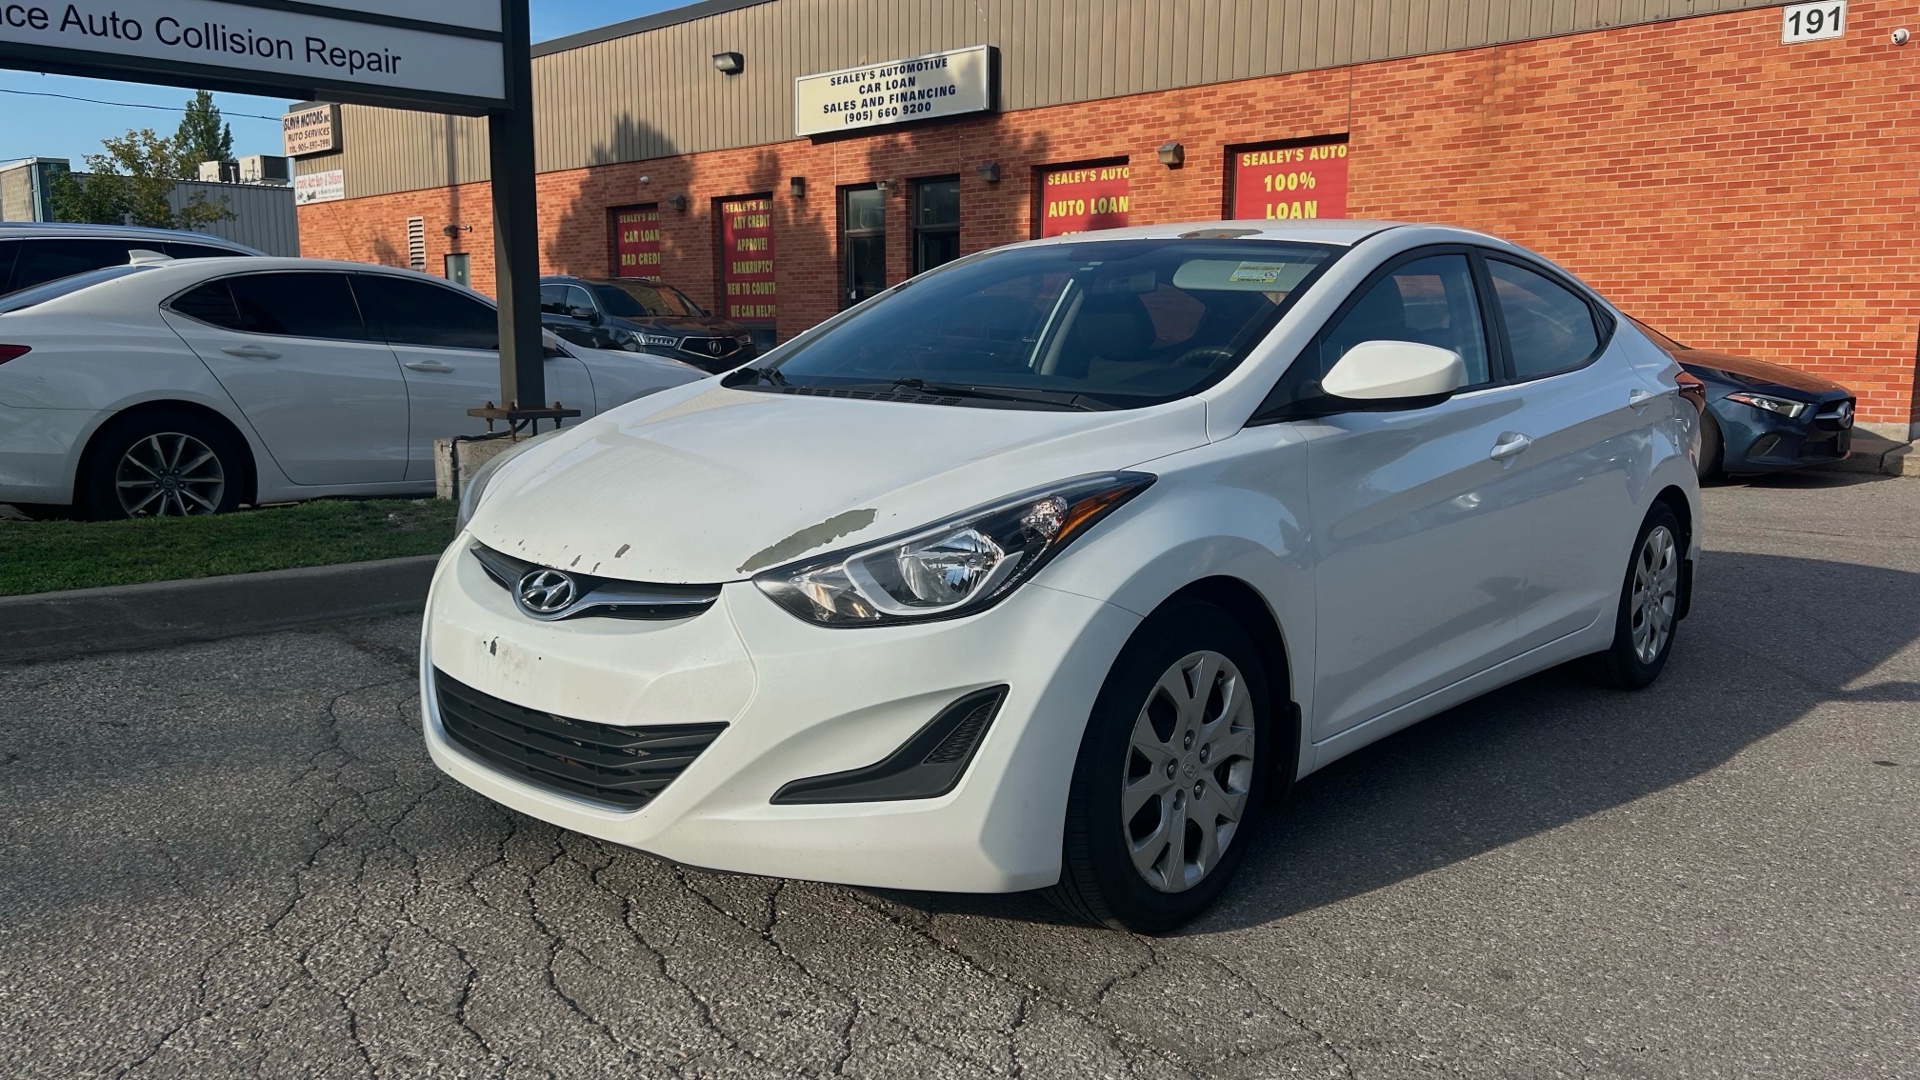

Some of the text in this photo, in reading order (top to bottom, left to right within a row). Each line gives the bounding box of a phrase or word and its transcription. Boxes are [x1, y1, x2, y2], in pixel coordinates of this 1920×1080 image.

[1788, 6, 1841, 36] 191
[0, 4, 402, 75] ce Auto Collision Repair
[830, 57, 948, 86] SEALEY'S AUTOMOTIVE
[859, 76, 916, 95] CAR LOAN
[823, 84, 956, 114] SALES AND FINANCING
[301, 110, 323, 128] MOTORS
[845, 102, 932, 124] (905) 660 9200
[288, 127, 330, 142] AUTO SERVICES
[1243, 144, 1347, 167] SEALEY'S AUTO
[1048, 167, 1129, 185] SEALEY'S AUTO
[1264, 171, 1316, 192] 100%
[725, 201, 756, 213] SEALEY'S
[1048, 196, 1129, 217] AUTO LOAN
[1266, 200, 1317, 219] LOAN
[619, 212, 646, 223] SEALEY'S
[733, 214, 770, 229] ANY CREDIT
[624, 229, 660, 243] CAR LOAN
[621, 254, 636, 266] BAD
[732, 260, 773, 274] BANKRUPTCY
[727, 282, 740, 295] NEW
[742, 282, 750, 295] TO
[730, 305, 739, 317] WE
[741, 305, 754, 317] CAN
